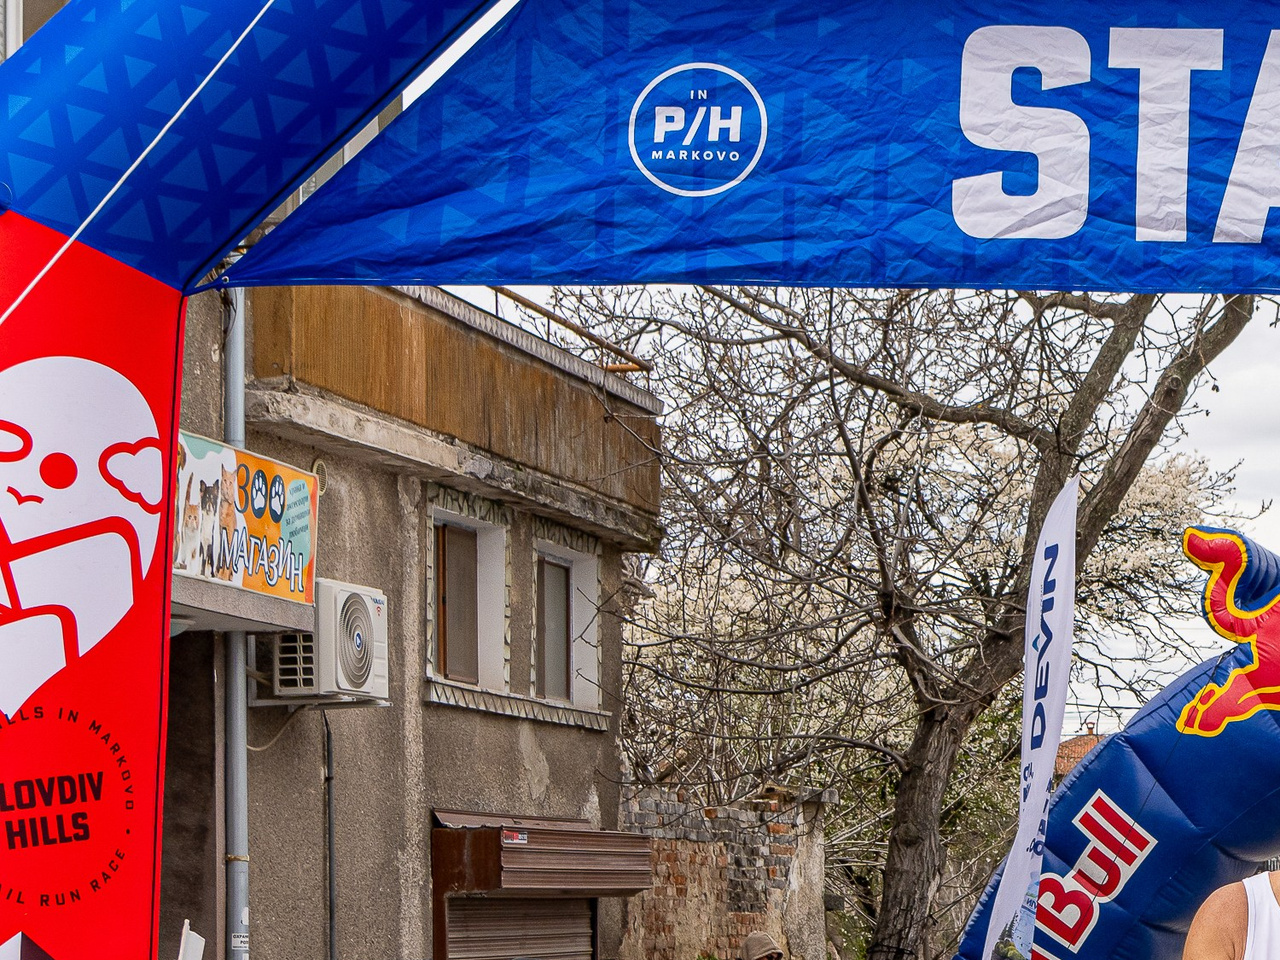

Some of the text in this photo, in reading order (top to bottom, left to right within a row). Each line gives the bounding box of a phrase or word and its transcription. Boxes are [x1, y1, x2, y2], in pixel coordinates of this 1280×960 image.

[689, 89, 708, 100] IN
[653, 105, 742, 146] P/H
[651, 149, 741, 163] MARKOVO
[219, 527, 304, 592] МАГАЗИН
[1030, 543, 1059, 751] DEVIN
[59, 707, 79, 724] IN
[88, 720, 134, 810] MARKOVO
[5, 812, 90, 850] HILLS
[40, 889, 81, 907] RUN
[89, 849, 126, 892] RACE
[1035, 794, 1152, 948] Bull
